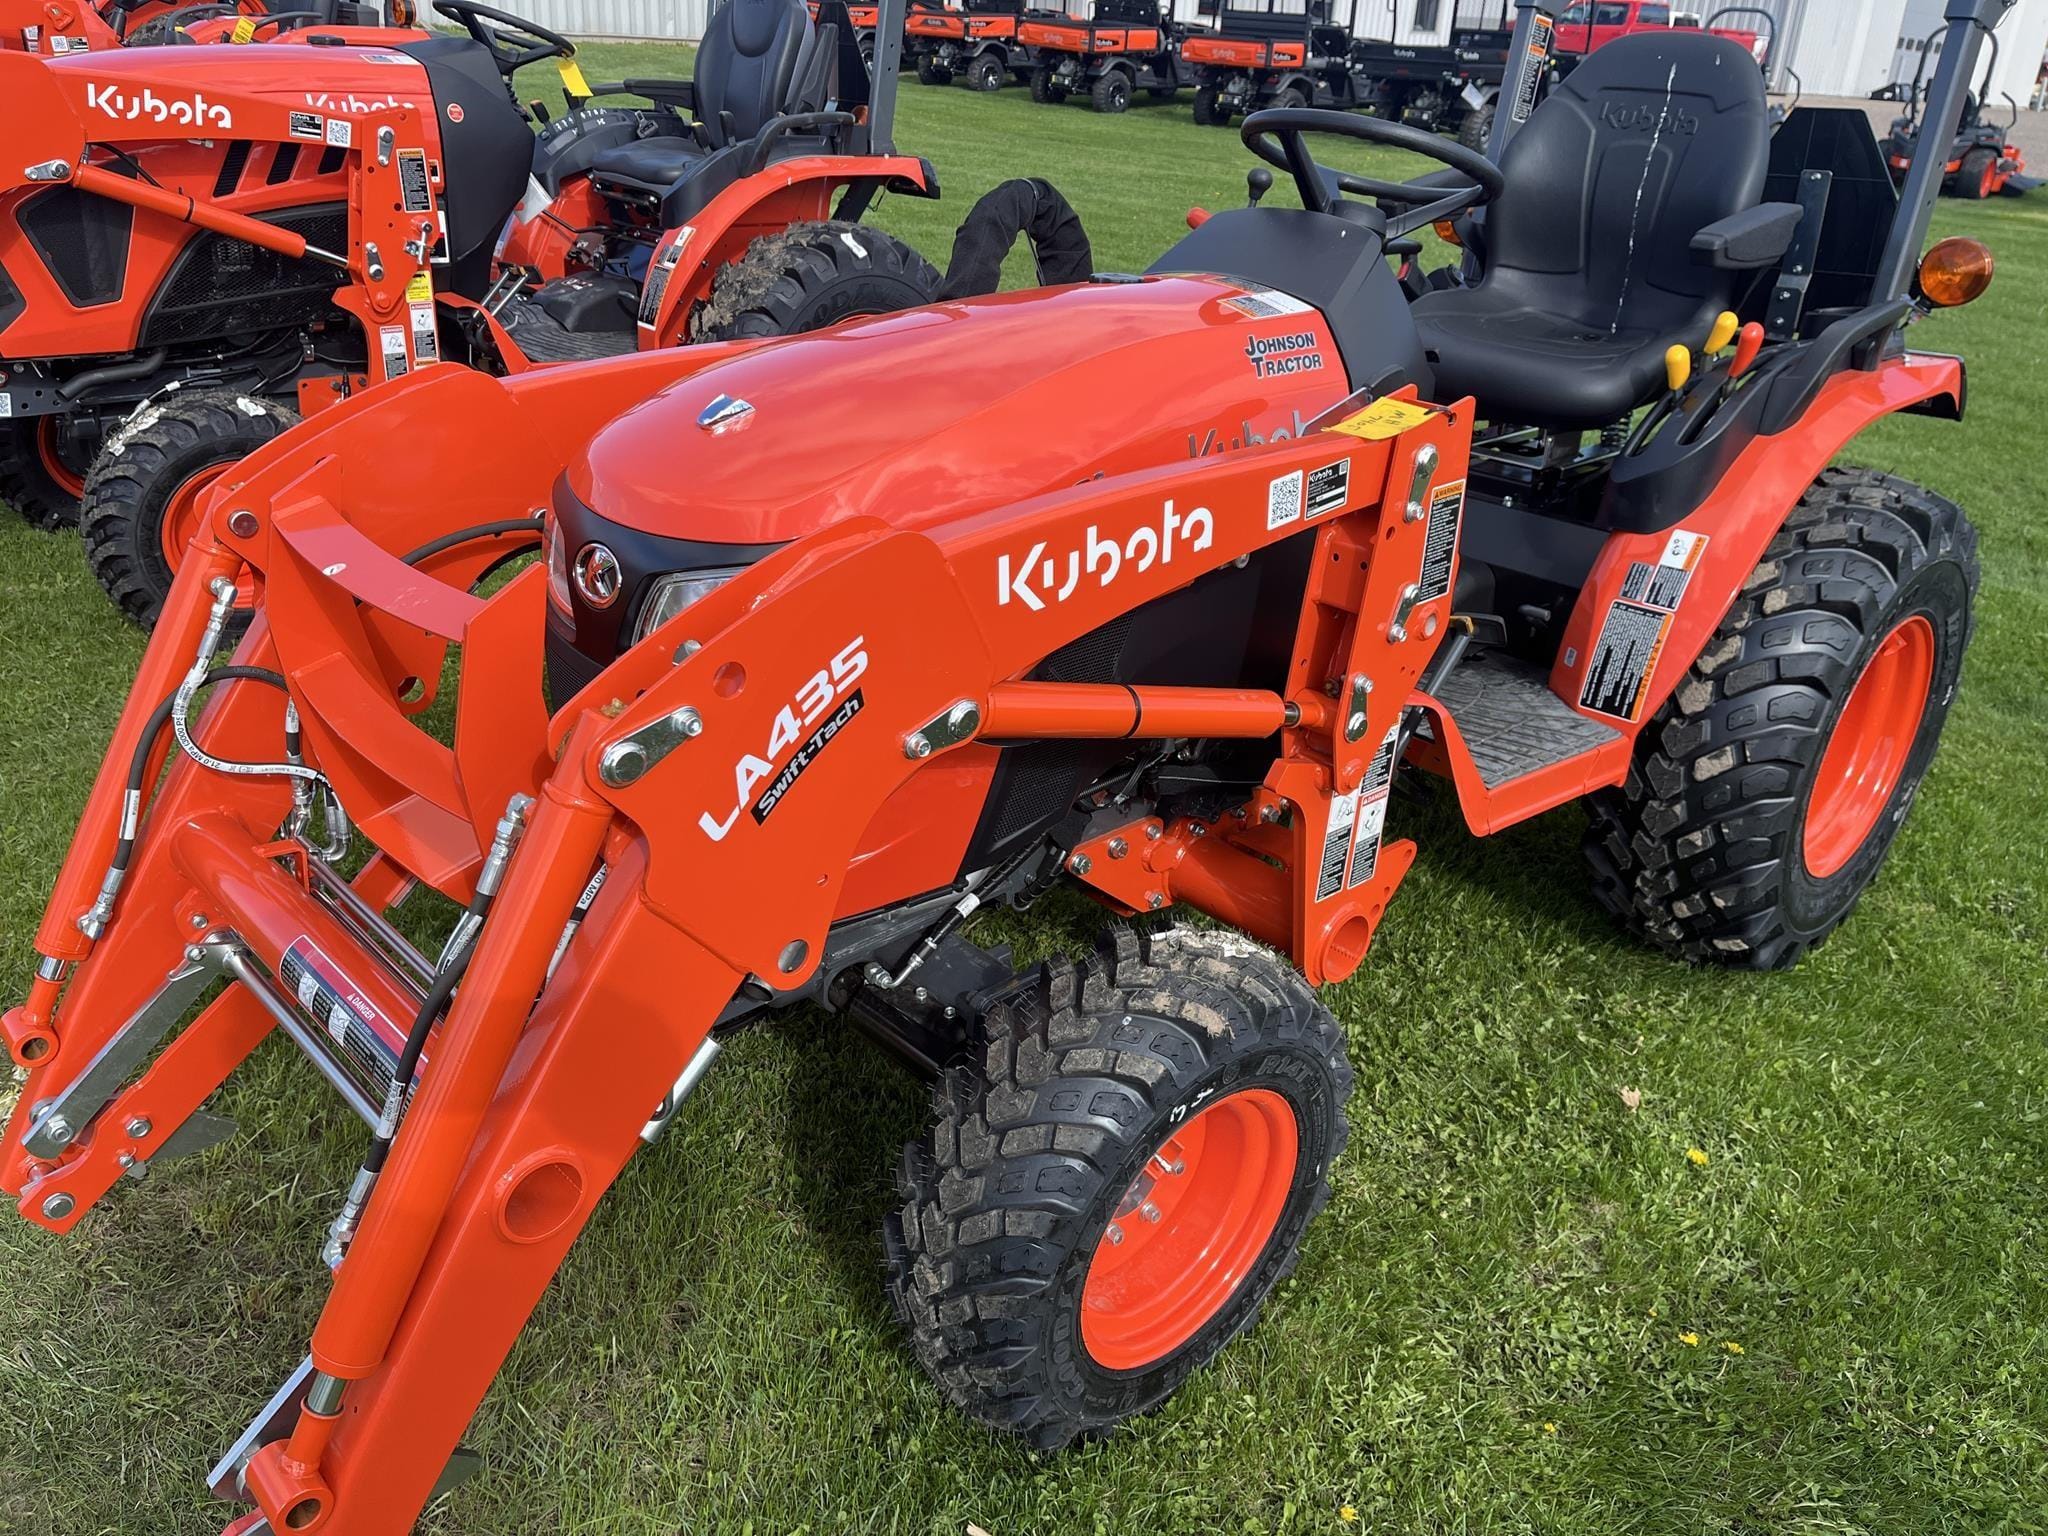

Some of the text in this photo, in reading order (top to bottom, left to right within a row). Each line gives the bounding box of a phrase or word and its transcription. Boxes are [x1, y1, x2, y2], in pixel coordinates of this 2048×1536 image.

[87, 83, 232, 129] Kubota
[1599, 101, 1700, 136] Kubota
[1245, 333, 1316, 356] JOHNSON
[1251, 354, 1323, 378] TRACTOR
[1309, 468, 1333, 482] Kubota
[998, 499, 1214, 612] Kubota
[698, 635, 870, 842] LA435
[757, 699, 861, 819] Swift-Tach
[351, 996, 377, 1021] DANGER
